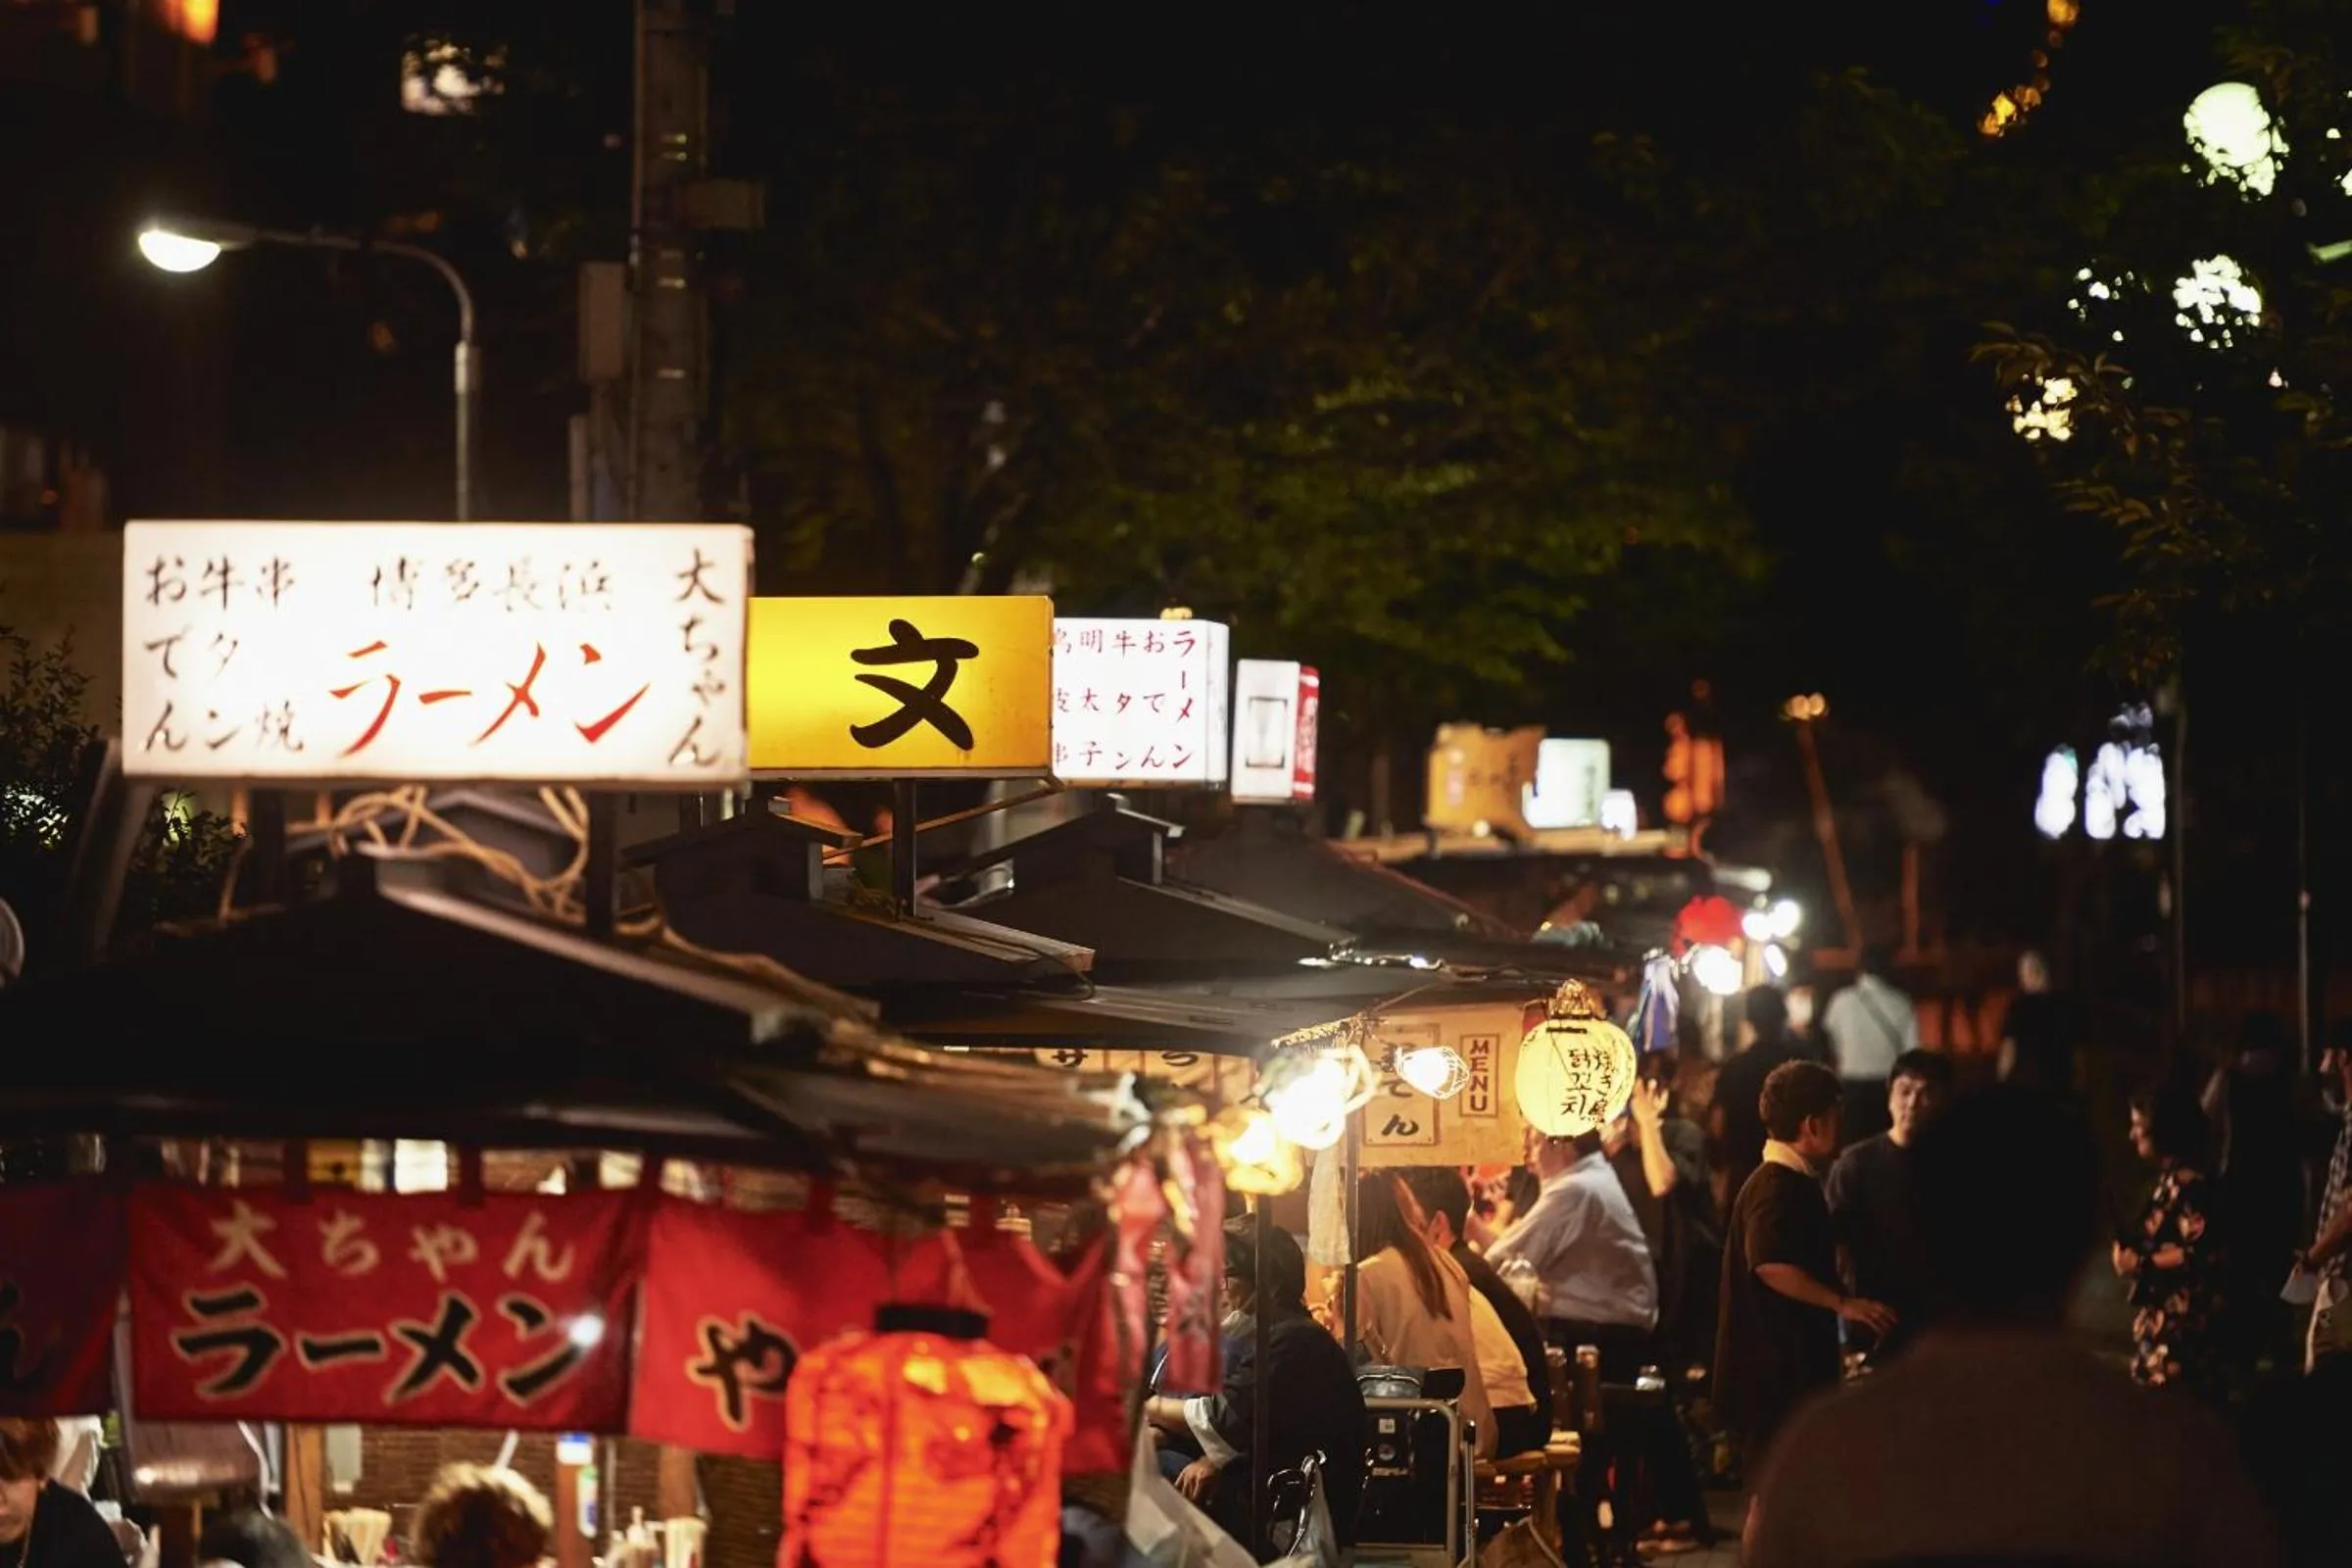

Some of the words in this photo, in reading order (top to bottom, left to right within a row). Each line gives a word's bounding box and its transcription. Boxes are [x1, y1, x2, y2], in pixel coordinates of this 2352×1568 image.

[145, 555, 190, 754] おでん
[200, 556, 245, 751] 牛タン
[328, 640, 652, 758] ラーメン
[668, 548, 727, 767] 大ちゃん
[850, 618, 979, 751] 文
[1112, 630, 1137, 770] 牛タン
[1141, 632, 1165, 768] おでん
[1172, 630, 1197, 769] ラーメン
[1469, 1039, 1490, 1112] MENU
[204, 1200, 576, 1282] 大ちゃん
[171, 1282, 598, 1406] ラーメン
